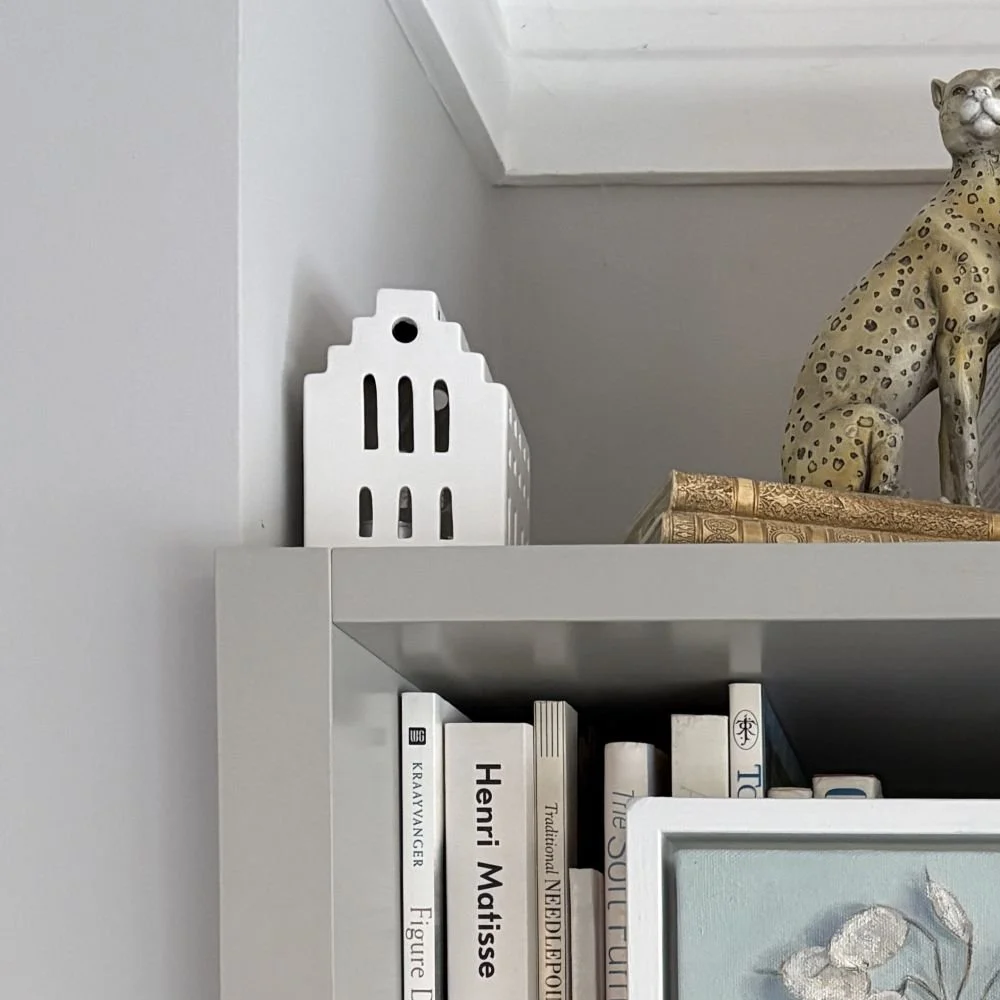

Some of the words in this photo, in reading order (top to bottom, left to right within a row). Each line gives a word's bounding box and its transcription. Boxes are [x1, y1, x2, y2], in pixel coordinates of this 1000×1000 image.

[412, 761, 425, 867] KRAAYVANGER
[475, 763, 502, 847] Henri
[544, 802, 560, 875] Traditional
[405, 906, 433, 979] Figure
[478, 861, 504, 979] Matisse
